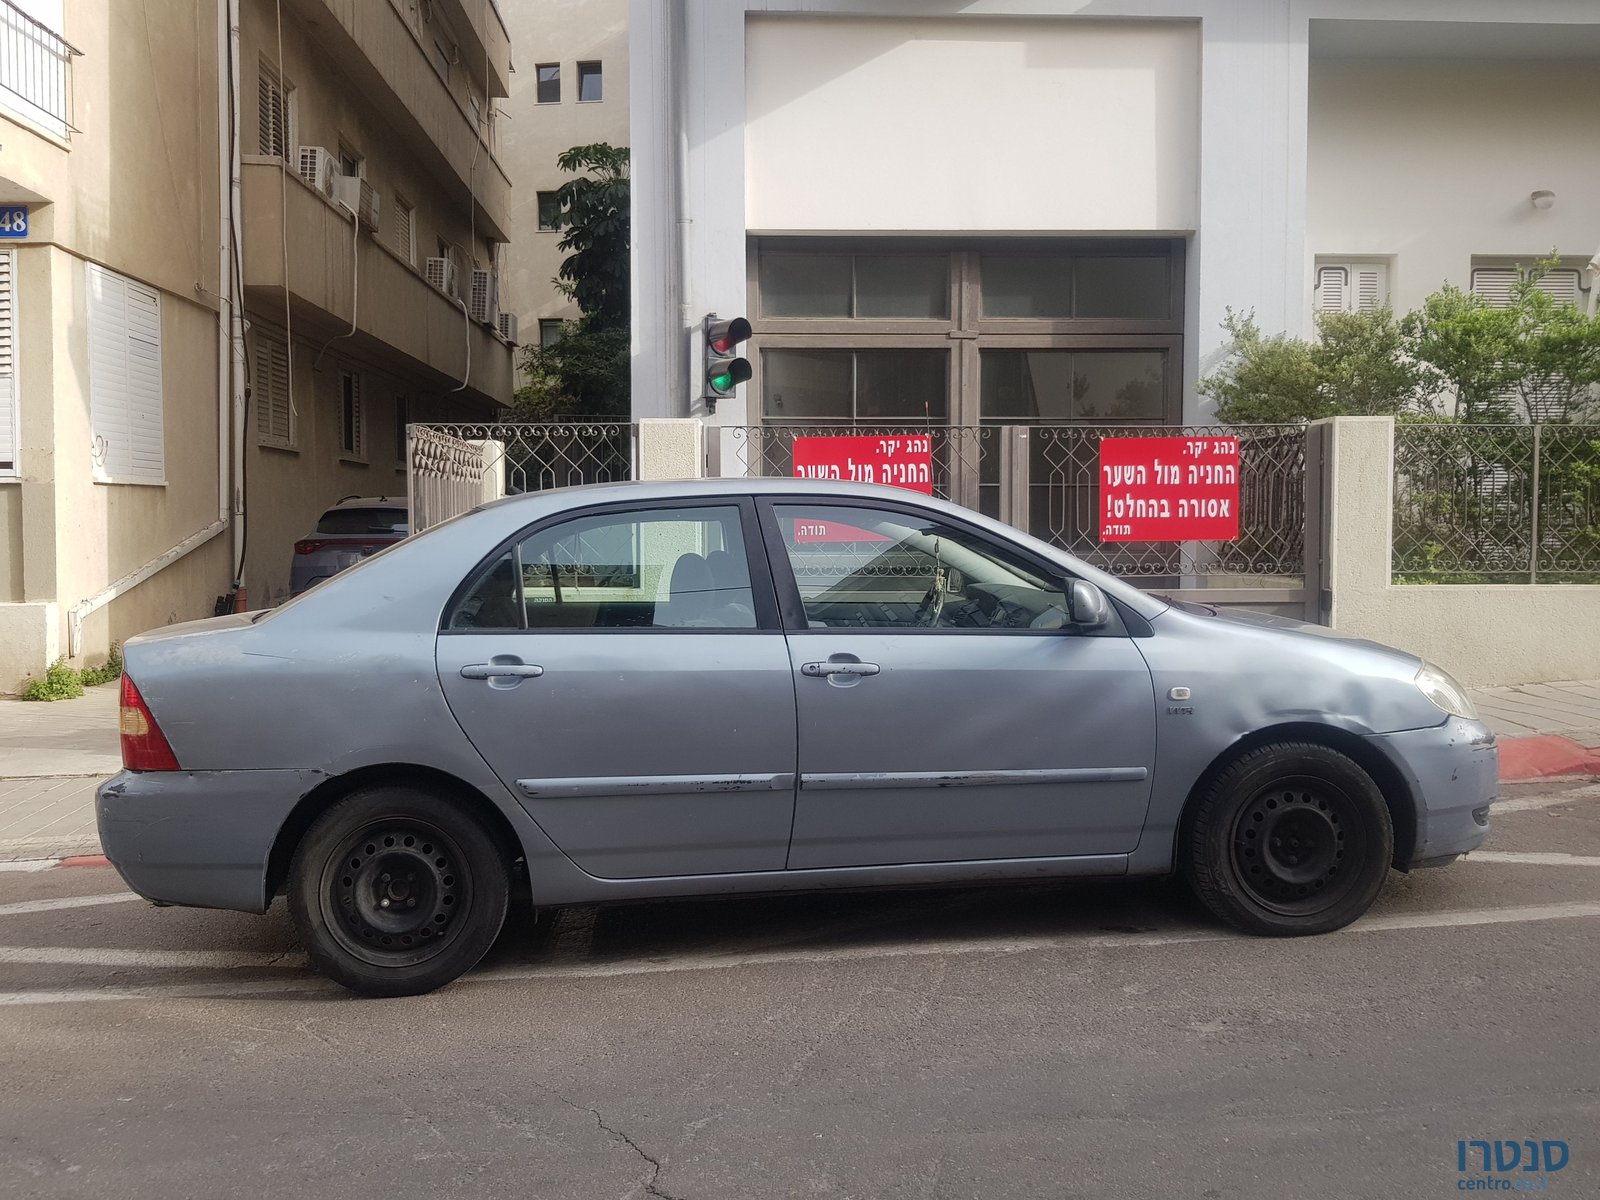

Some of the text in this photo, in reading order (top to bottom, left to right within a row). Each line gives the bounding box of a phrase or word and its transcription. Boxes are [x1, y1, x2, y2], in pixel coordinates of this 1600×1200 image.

[0, 211, 26, 232] 48
[906, 440, 928, 453] נהג
[1213, 441, 1235, 455] נהג
[847, 458, 874, 483] מול
[882, 463, 929, 484] החניה
[1103, 459, 1235, 487] החניה מול השער
[1106, 493, 1230, 519] אסורה בהחלט!
